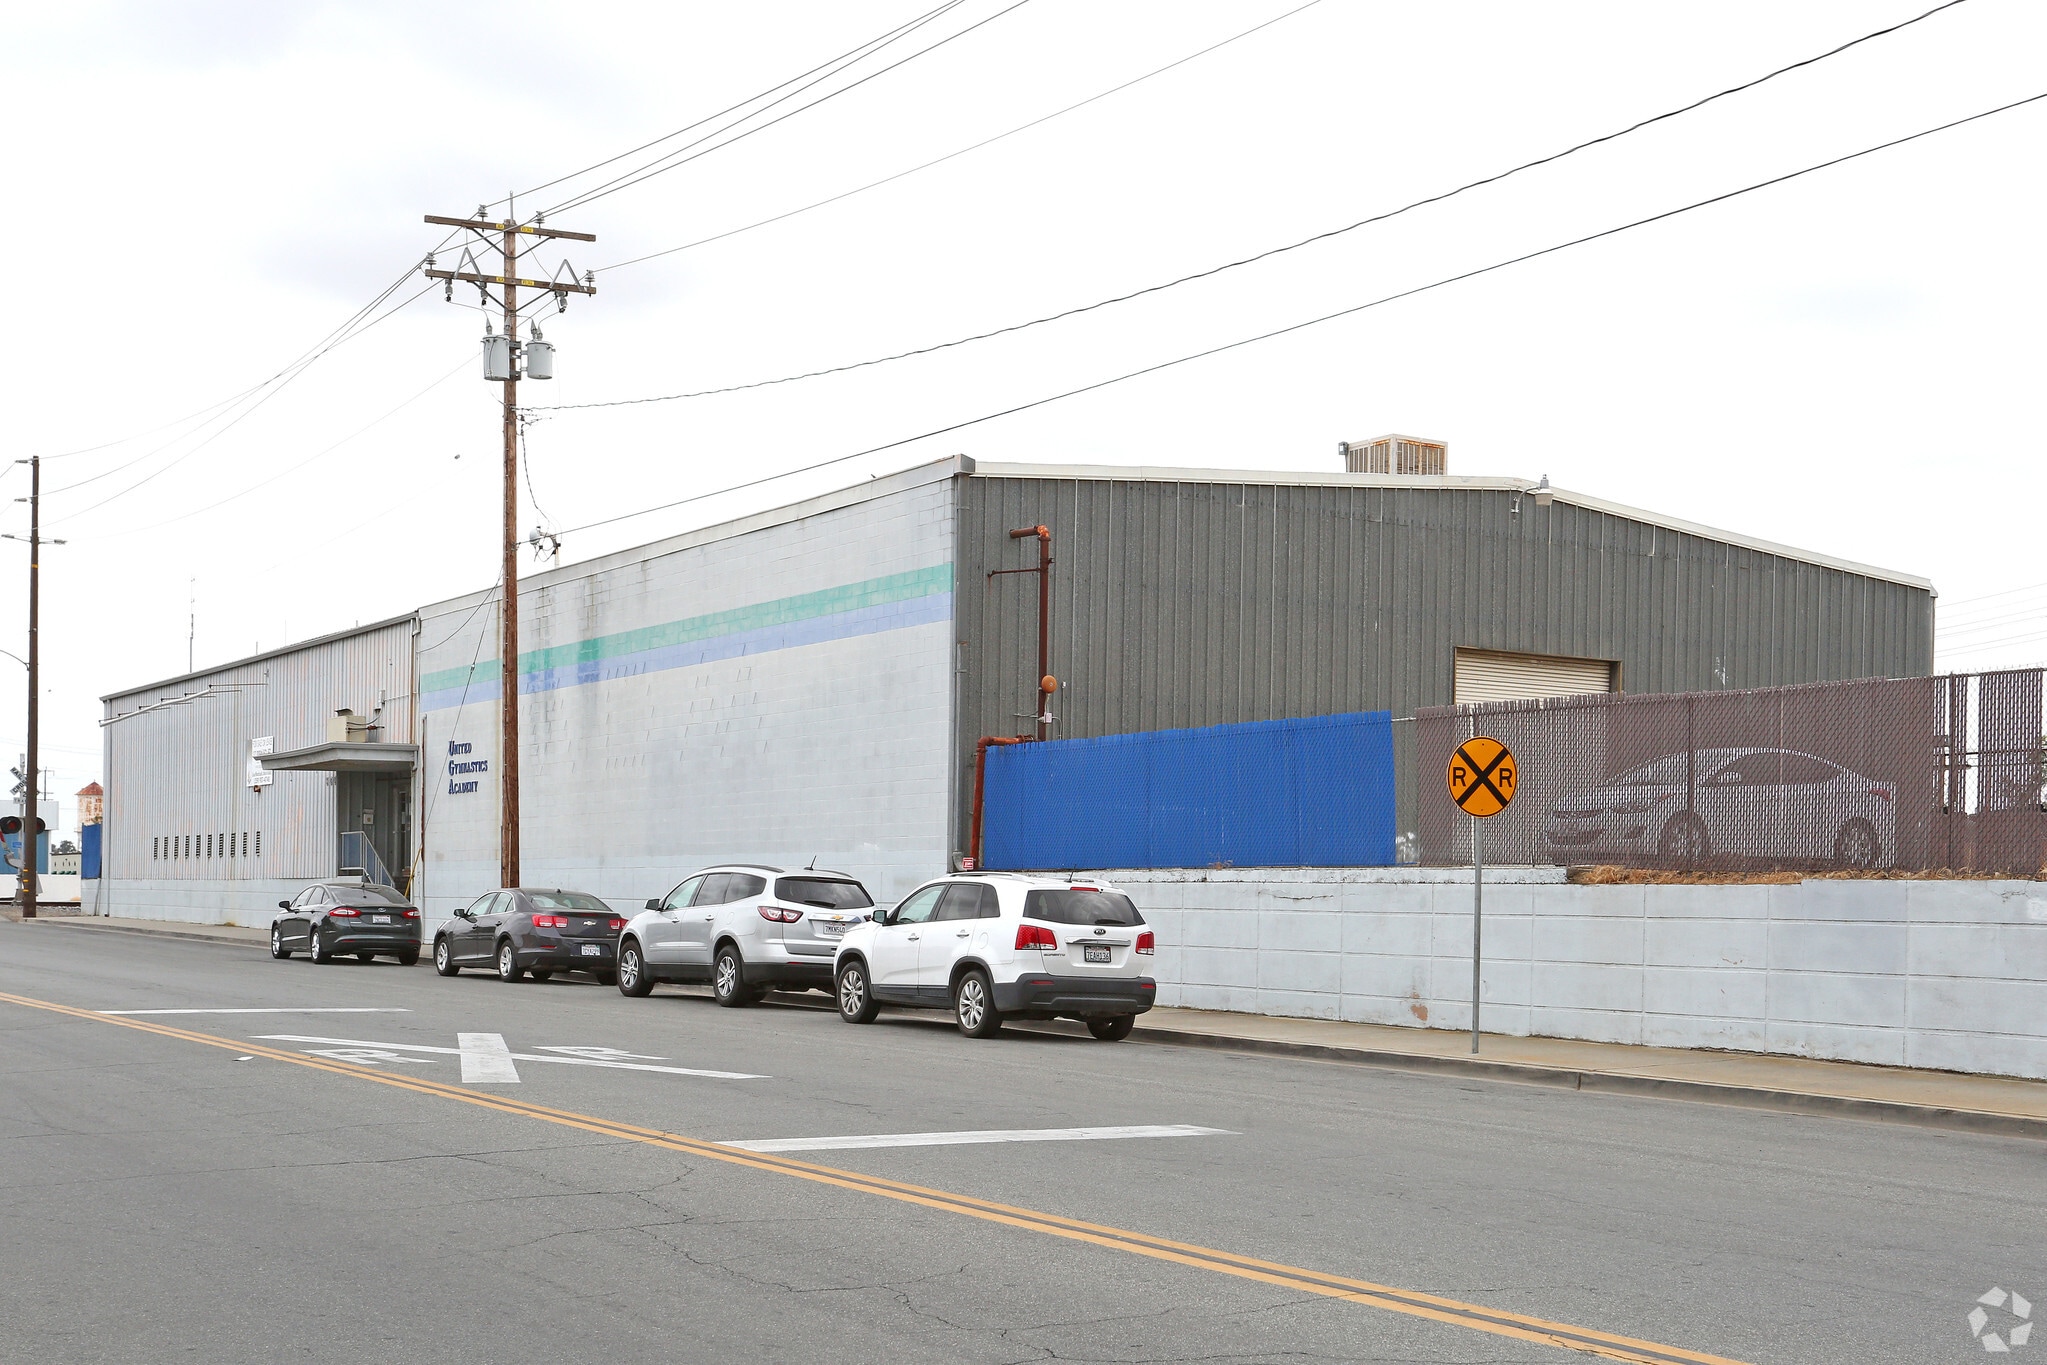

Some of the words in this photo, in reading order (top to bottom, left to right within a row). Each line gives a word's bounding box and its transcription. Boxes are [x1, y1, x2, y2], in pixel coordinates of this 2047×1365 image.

[449, 740, 472, 756] UNITED
[448, 760, 488, 776] GYMNASTICS
[1453, 767, 1466, 786] R
[1499, 768, 1512, 787] R
[448, 779, 479, 795] ACADEMY
